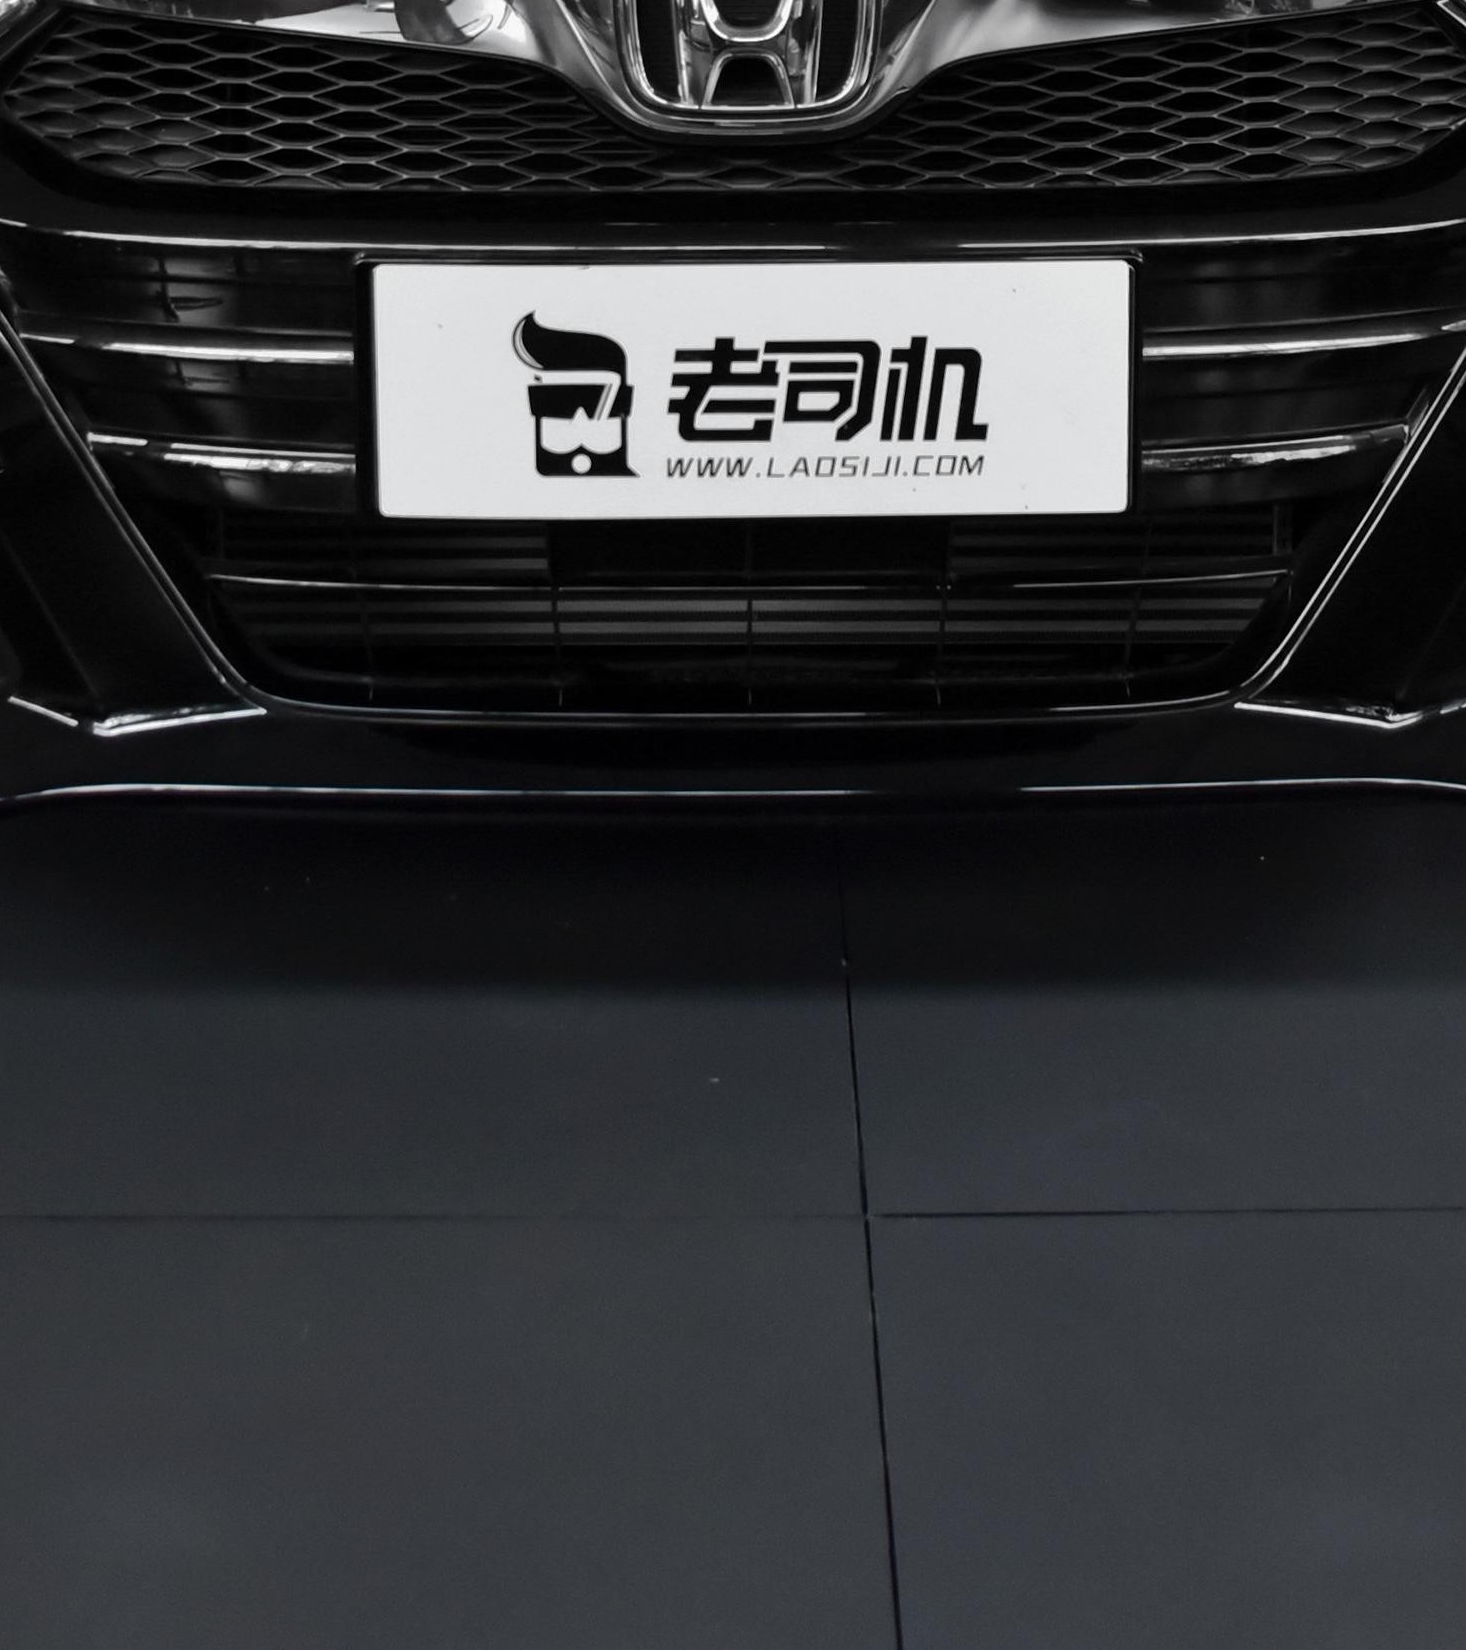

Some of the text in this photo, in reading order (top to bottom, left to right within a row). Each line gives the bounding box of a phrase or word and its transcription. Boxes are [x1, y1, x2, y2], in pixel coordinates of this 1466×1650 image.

[666, 335, 990, 443] 老司机
[665, 453, 986, 479] WWW.LAOSIJI.COM
